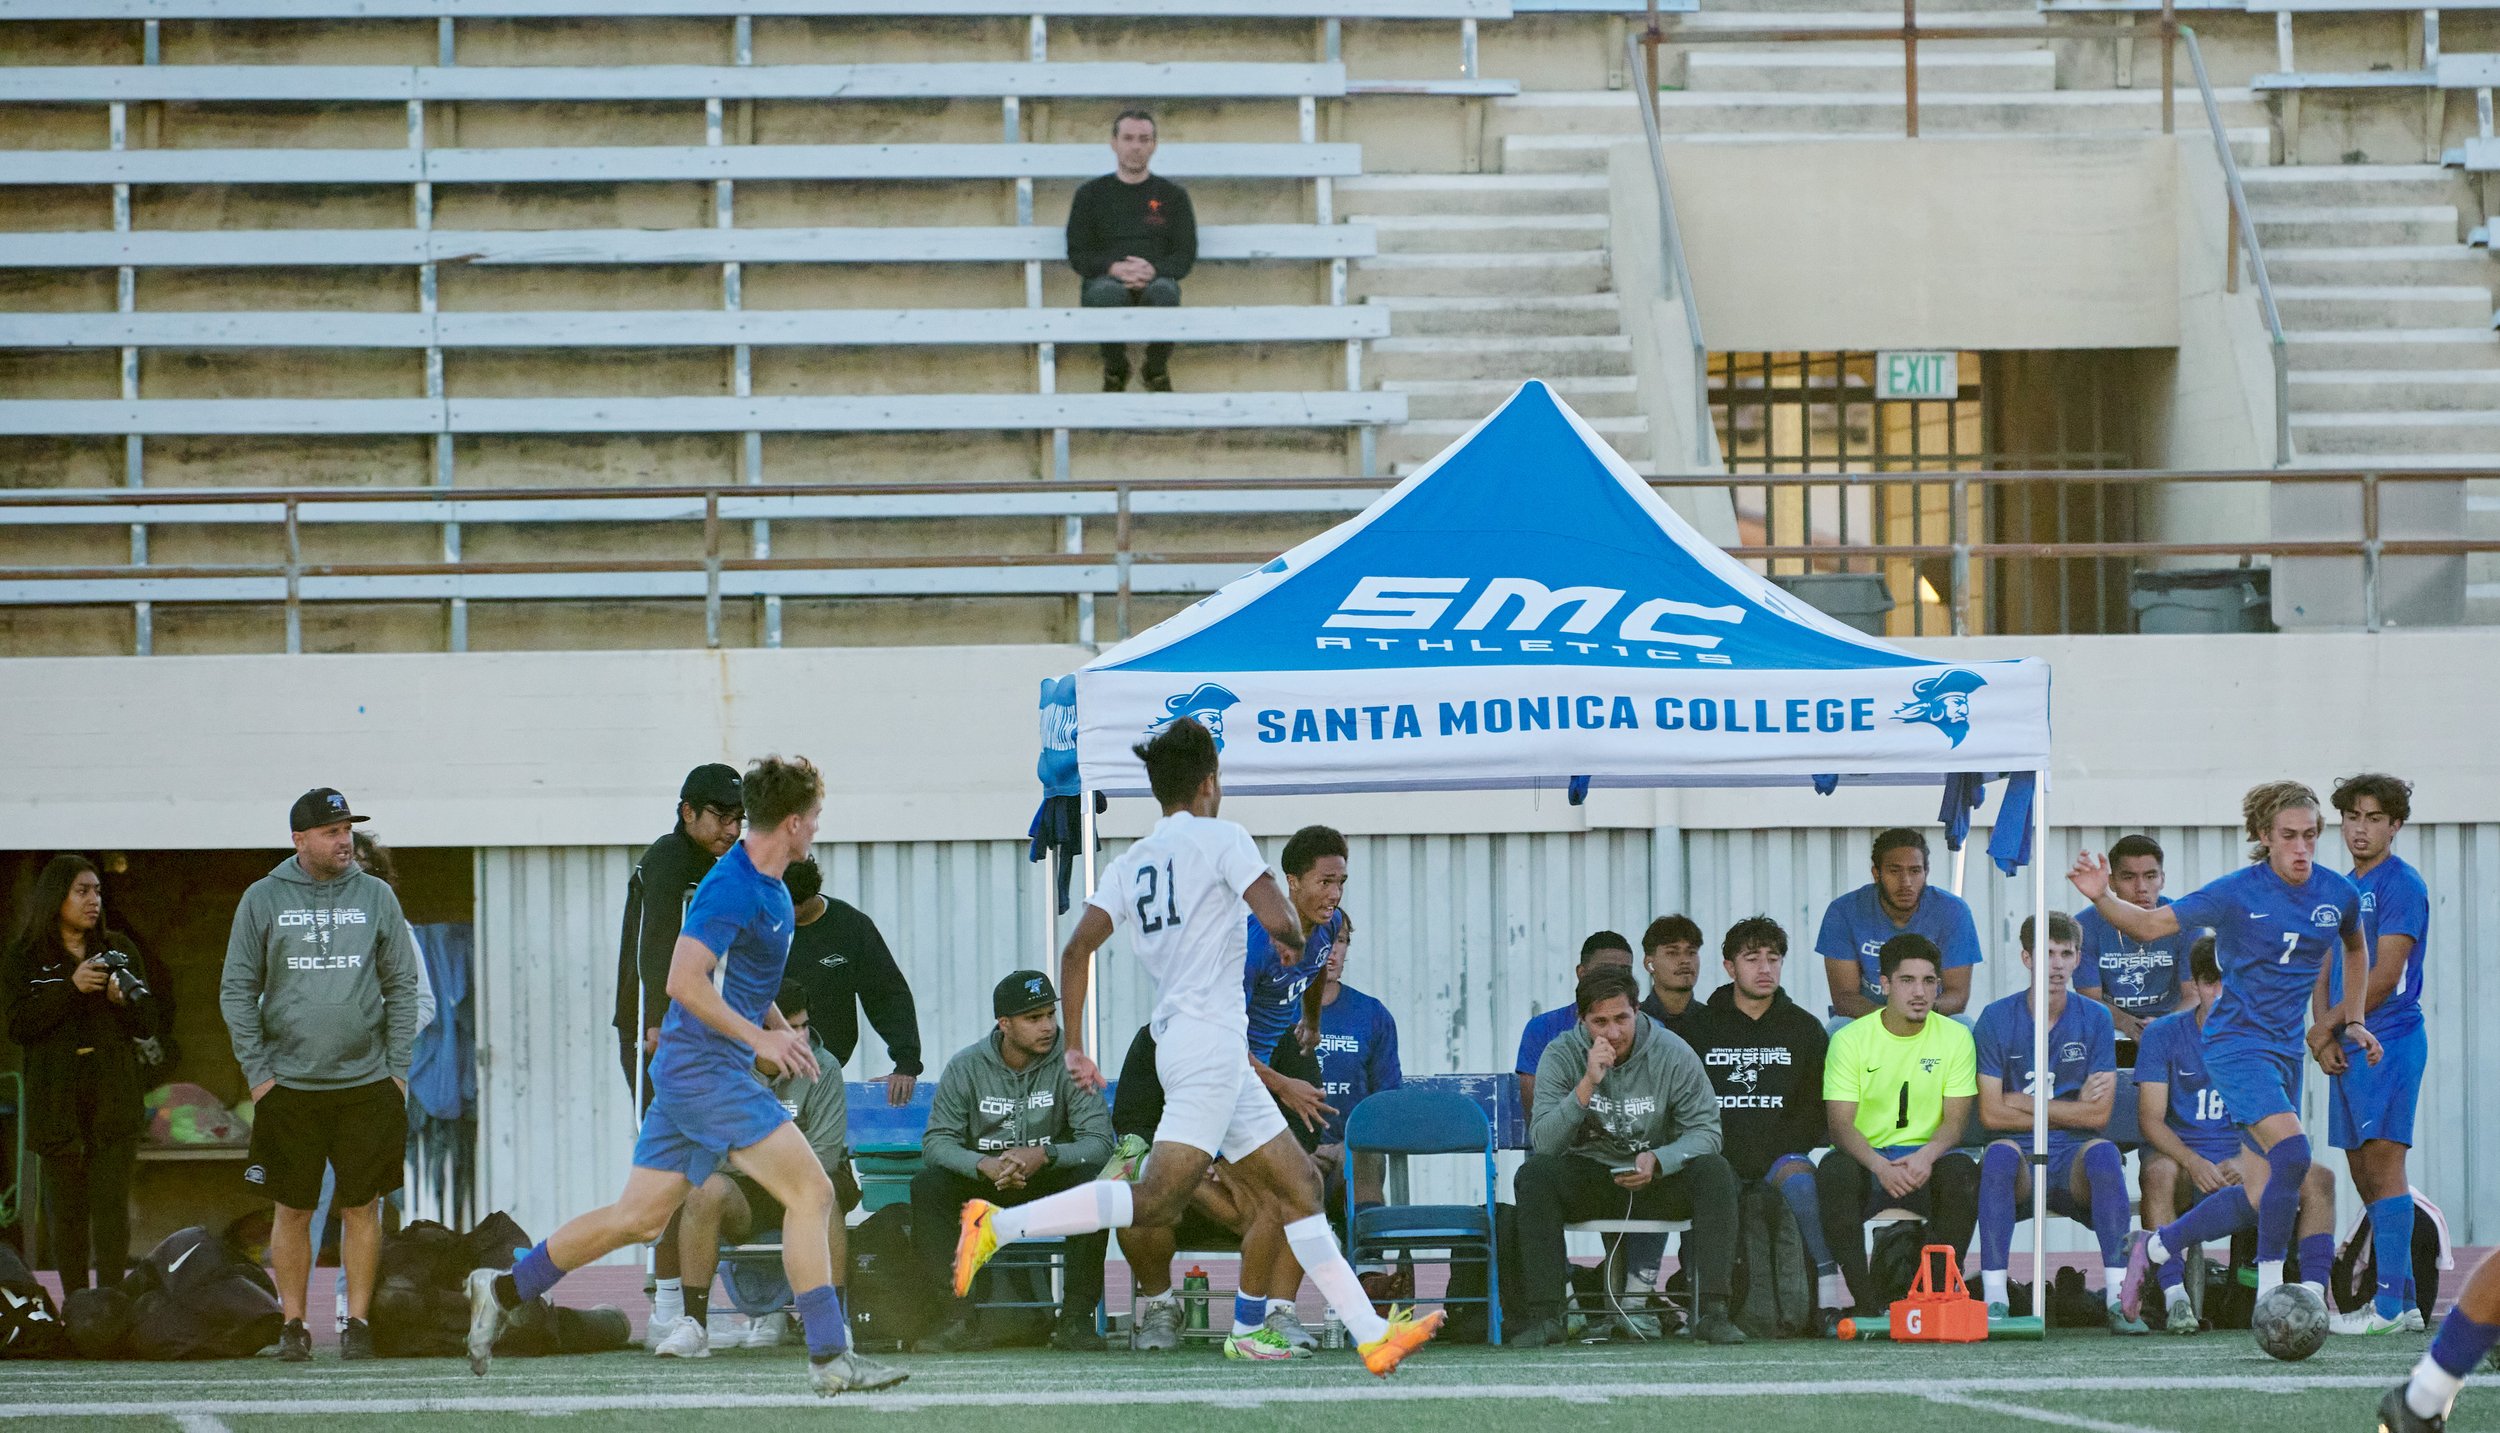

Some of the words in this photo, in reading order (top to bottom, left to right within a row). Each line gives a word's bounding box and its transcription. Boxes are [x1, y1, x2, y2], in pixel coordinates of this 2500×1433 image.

[1888, 354, 1945, 394] EXIT
[1321, 576, 1747, 649] SMC
[1316, 636, 1732, 665] ATHLETICS
[1257, 704, 1422, 744] SANTA
[1439, 695, 1639, 736] MONICA
[1655, 697, 1875, 733] COLLEGE
[1135, 857, 1182, 934] 21
[278, 912, 367, 926] CORSAIRS
[2099, 955, 2173, 969] CORSAIRS
[2279, 932, 2300, 964] 7
[1705, 1052, 1792, 1066] CORSAIRS
[1895, 1081, 1909, 1129] 1
[2195, 1088, 2224, 1120] 18
[1906, 1309, 1922, 1334] G
